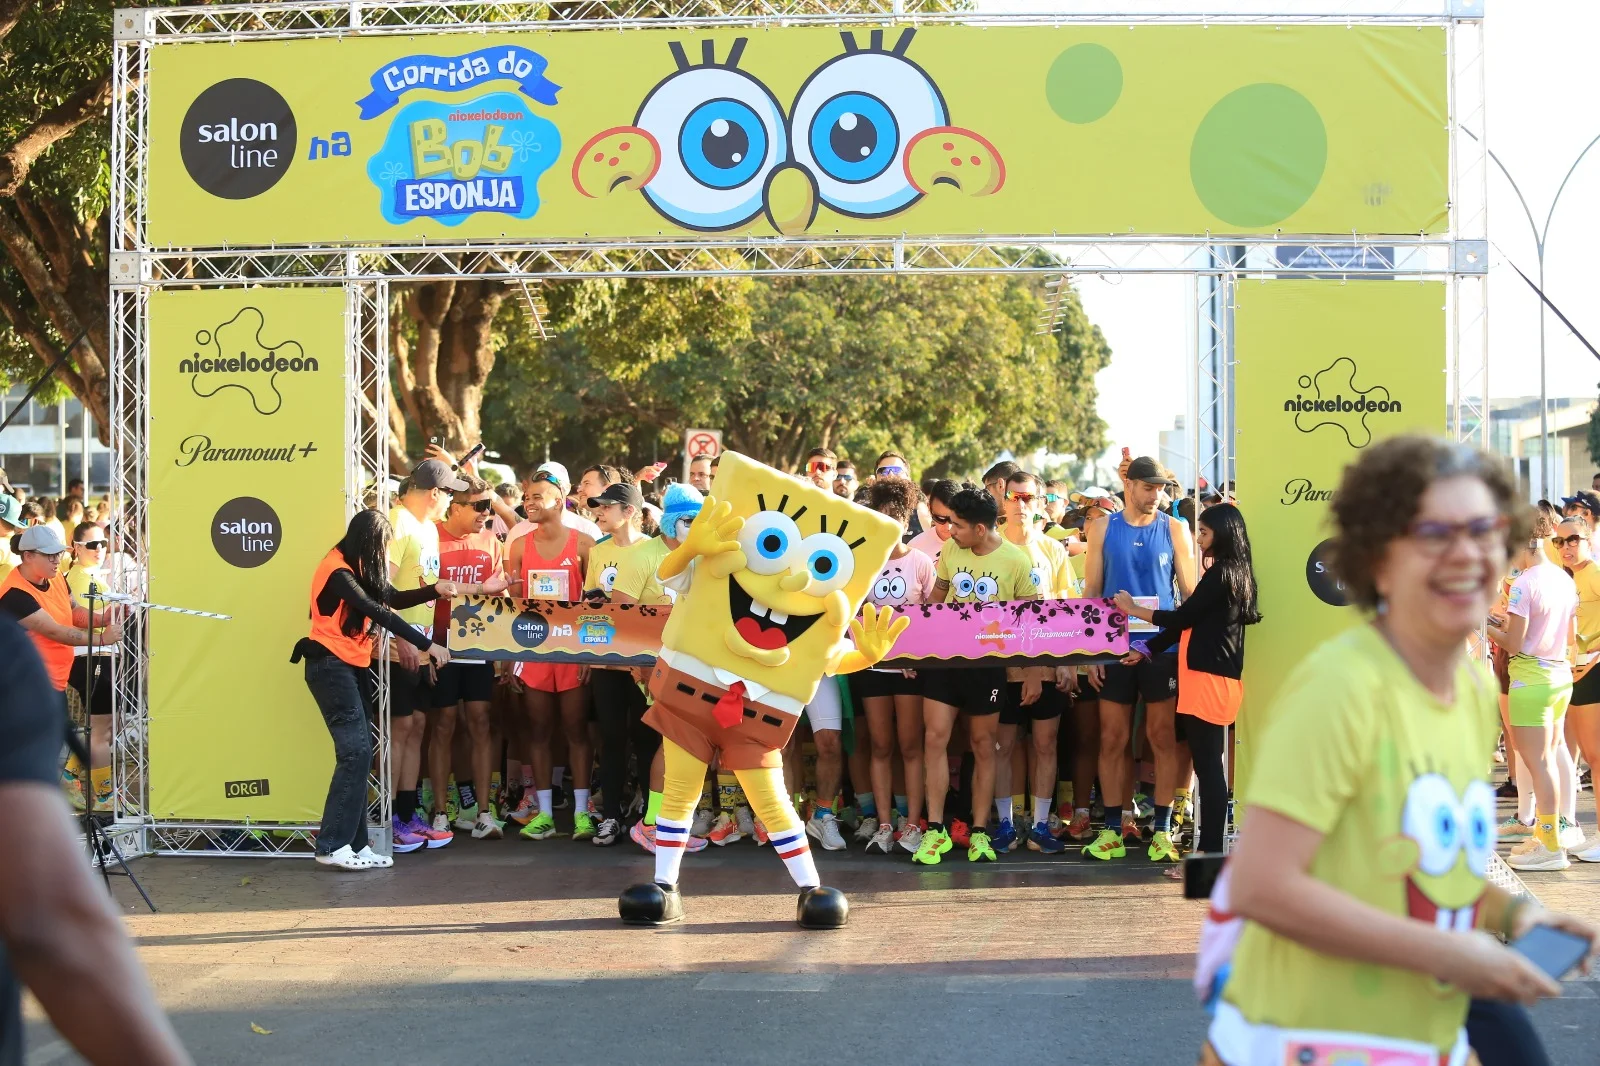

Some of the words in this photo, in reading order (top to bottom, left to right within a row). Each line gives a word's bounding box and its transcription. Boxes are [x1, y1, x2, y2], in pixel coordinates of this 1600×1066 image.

[382, 56, 490, 92] Corrida
[497, 50, 533, 79] do
[448, 109, 524, 121] nickelodeon
[198, 117, 278, 143] salon
[308, 131, 352, 161] na
[408, 117, 515, 181] Bob
[231, 144, 278, 168] line
[405, 178, 517, 211] ESPONJA
[179, 351, 319, 373] nickelodeon
[1284, 394, 1402, 413] nickelodeon
[219, 518, 273, 535] salon
[242, 535, 274, 552] line
[446, 564, 484, 584] TIME
[517, 622, 544, 632] salon
[527, 631, 544, 640] line
[551, 624, 573, 637] na
[974, 632, 1017, 640] nickelodeon
